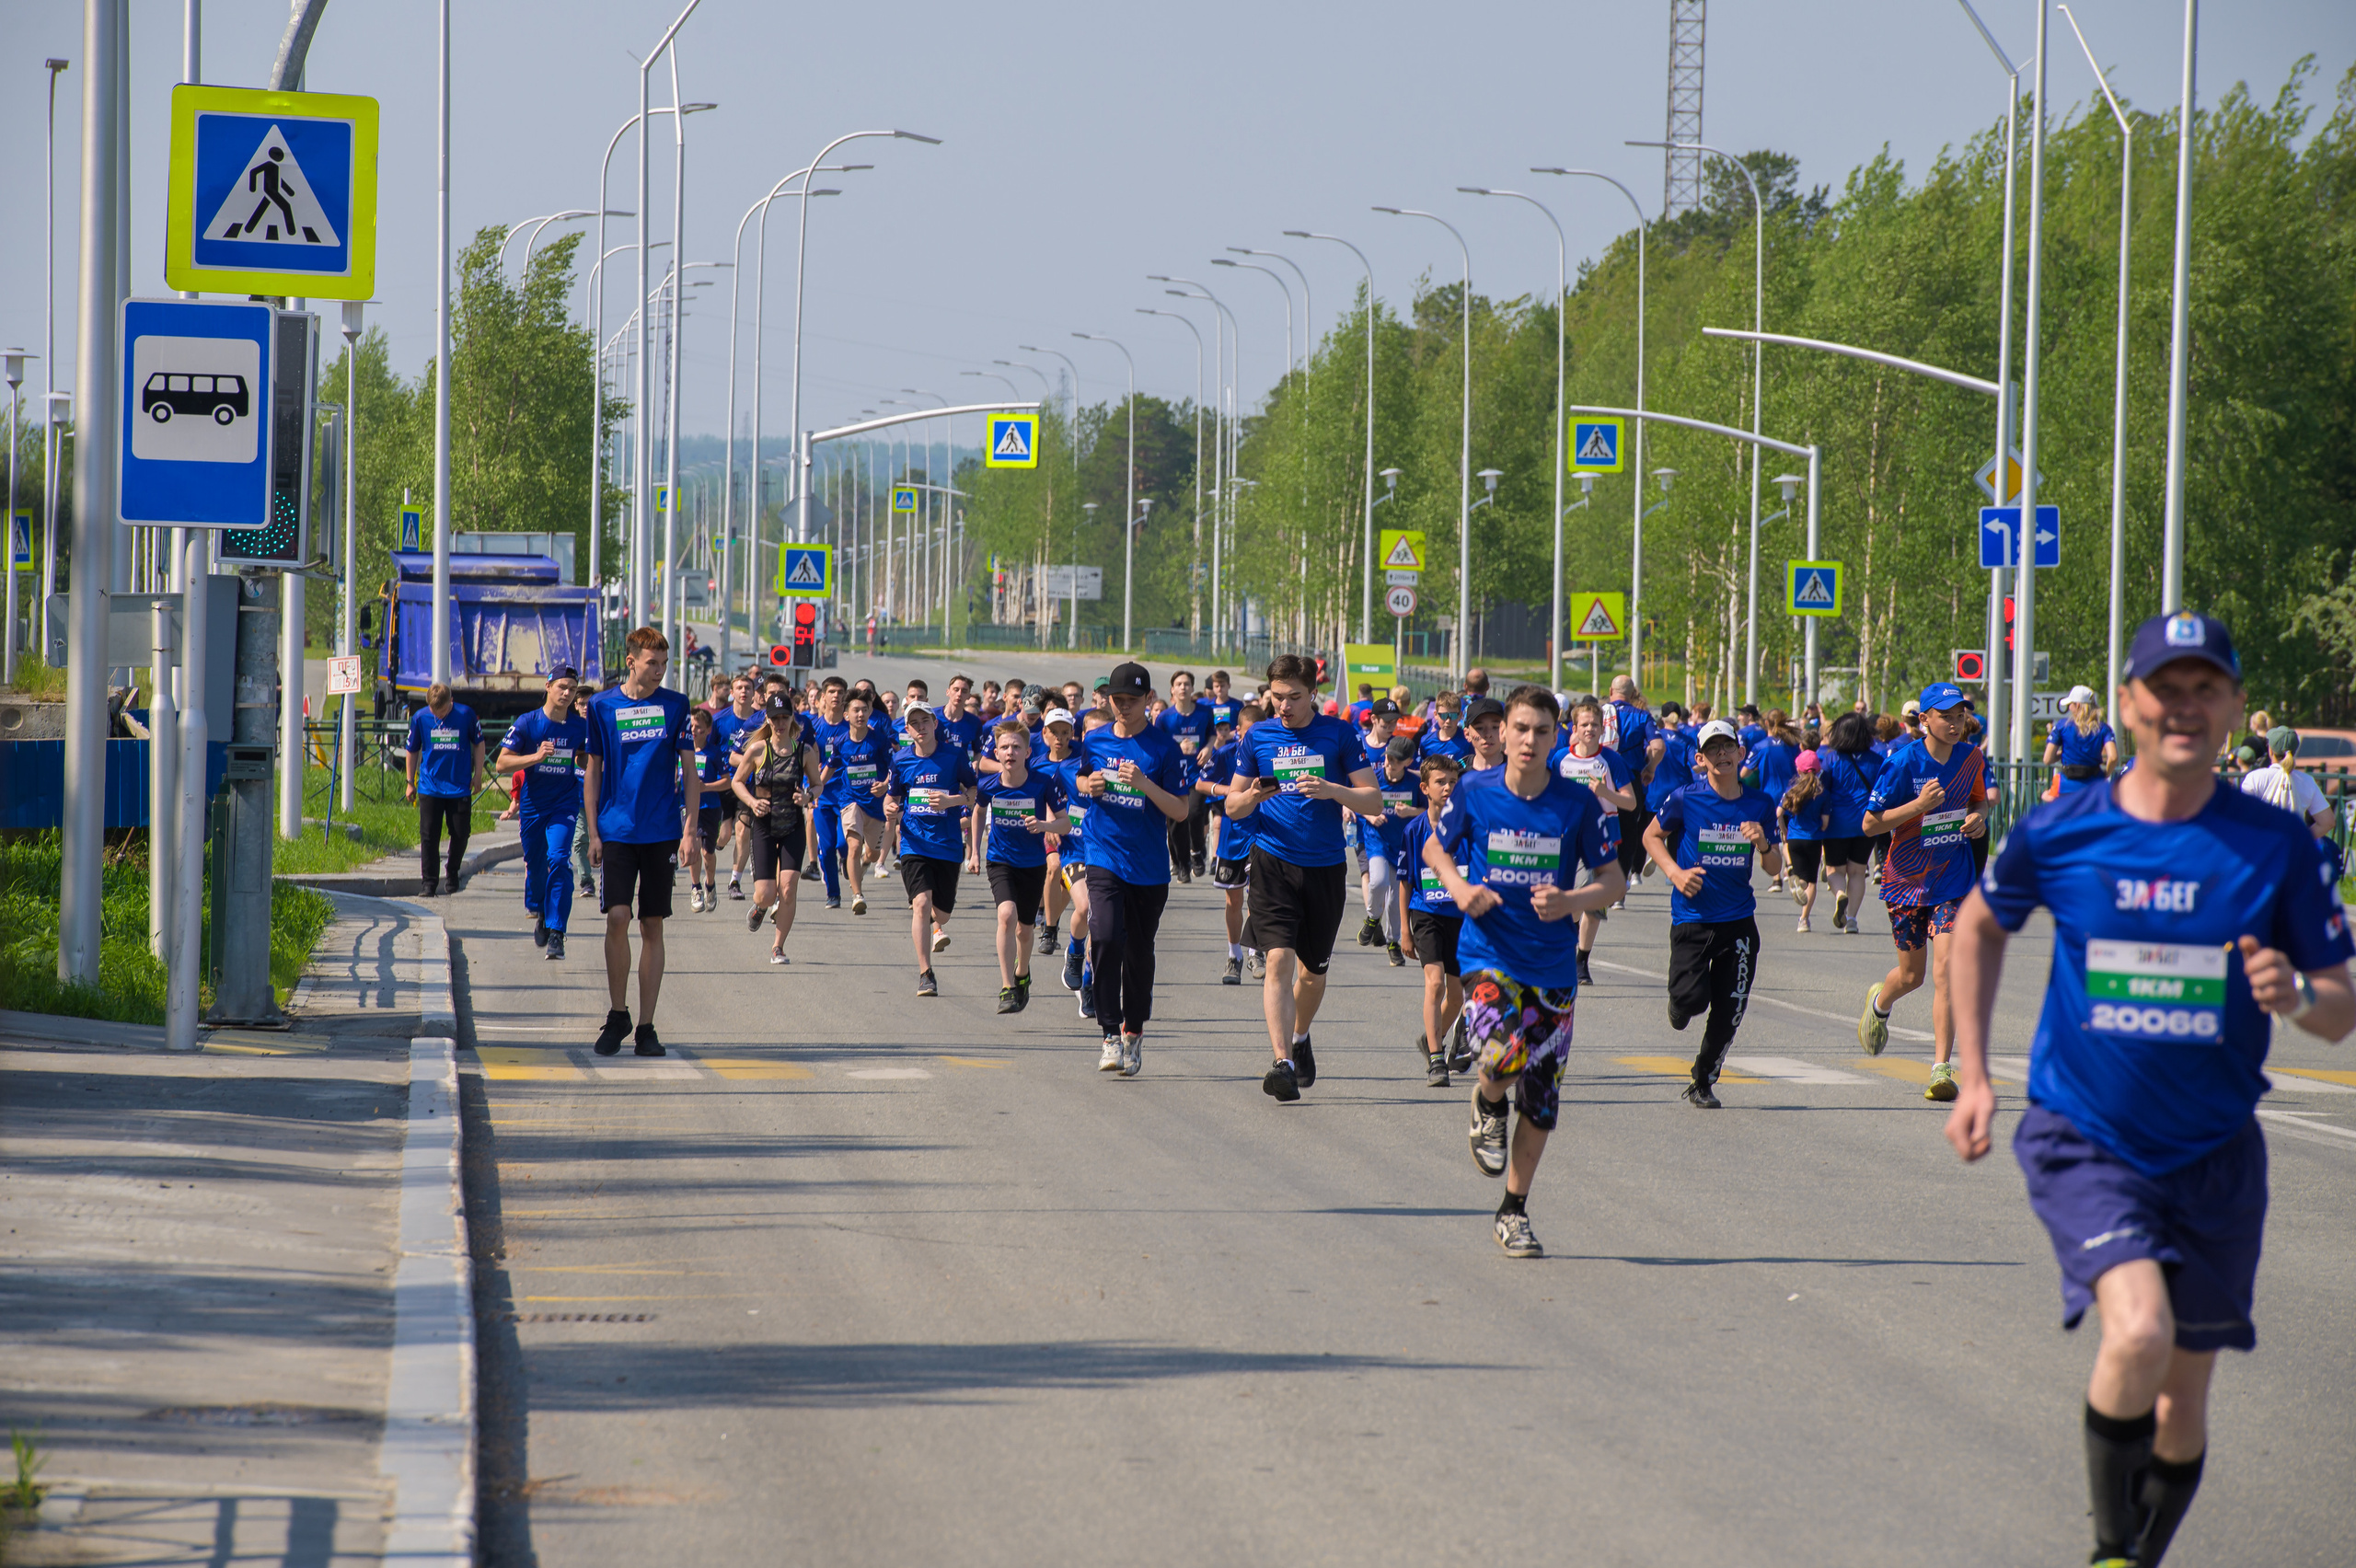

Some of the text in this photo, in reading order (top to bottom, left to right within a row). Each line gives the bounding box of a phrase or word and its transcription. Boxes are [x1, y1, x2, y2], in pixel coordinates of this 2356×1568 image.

[1392, 594, 1409, 607] 40
[795, 626, 814, 645] 54
[621, 728, 664, 742] 20487
[538, 766, 567, 774] 20110
[1102, 794, 1143, 808] 20078
[995, 817, 1025, 826] 2000
[1923, 834, 1962, 847] 20001
[1702, 856, 1746, 866] 20012
[1490, 868, 1555, 885] 20054
[1426, 890, 1452, 901] 204
[1730, 937, 1750, 1027] NARUTO
[2090, 1004, 2218, 1037] 20066
